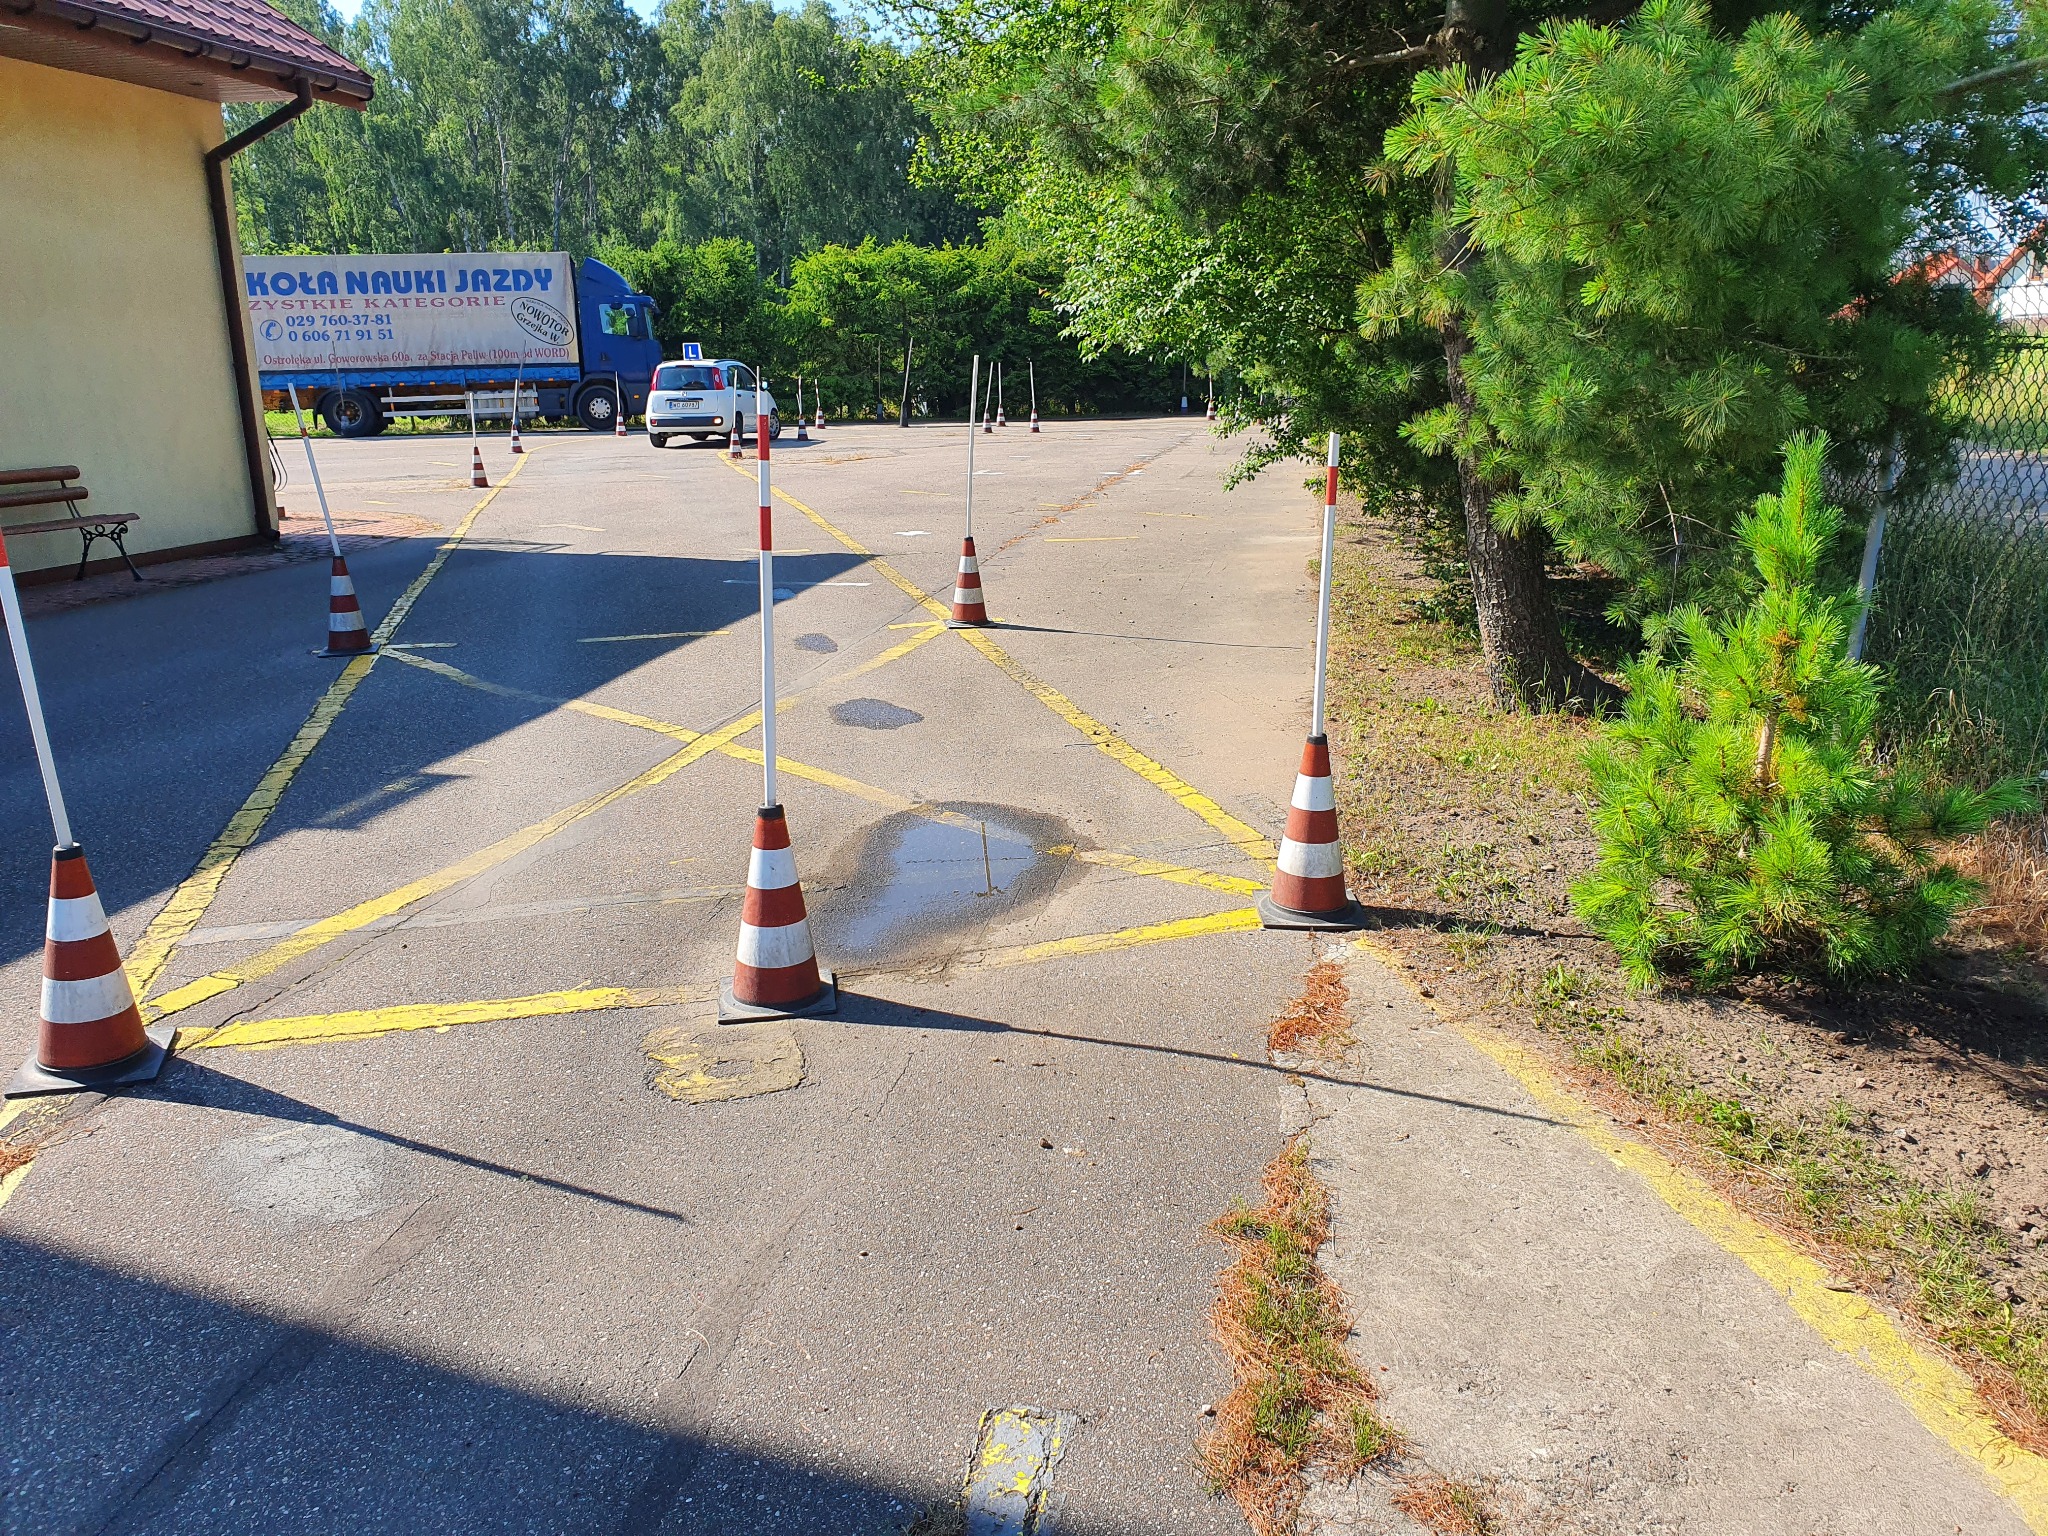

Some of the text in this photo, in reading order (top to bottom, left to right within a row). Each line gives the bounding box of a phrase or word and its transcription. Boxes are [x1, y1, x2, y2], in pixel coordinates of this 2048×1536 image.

[346, 269, 447, 295] NAUKI
[455, 268, 552, 293] JAZDY
[364, 296, 506, 309] KATEGORIE
[286, 313, 392, 327] 029 760-37-81
[517, 313, 548, 337] Grzejka
[520, 301, 569, 337] NOWOTOR
[289, 328, 394, 341] 0 606 71 91 51
[534, 347, 570, 359] WORD)
[688, 345, 696, 358] L
